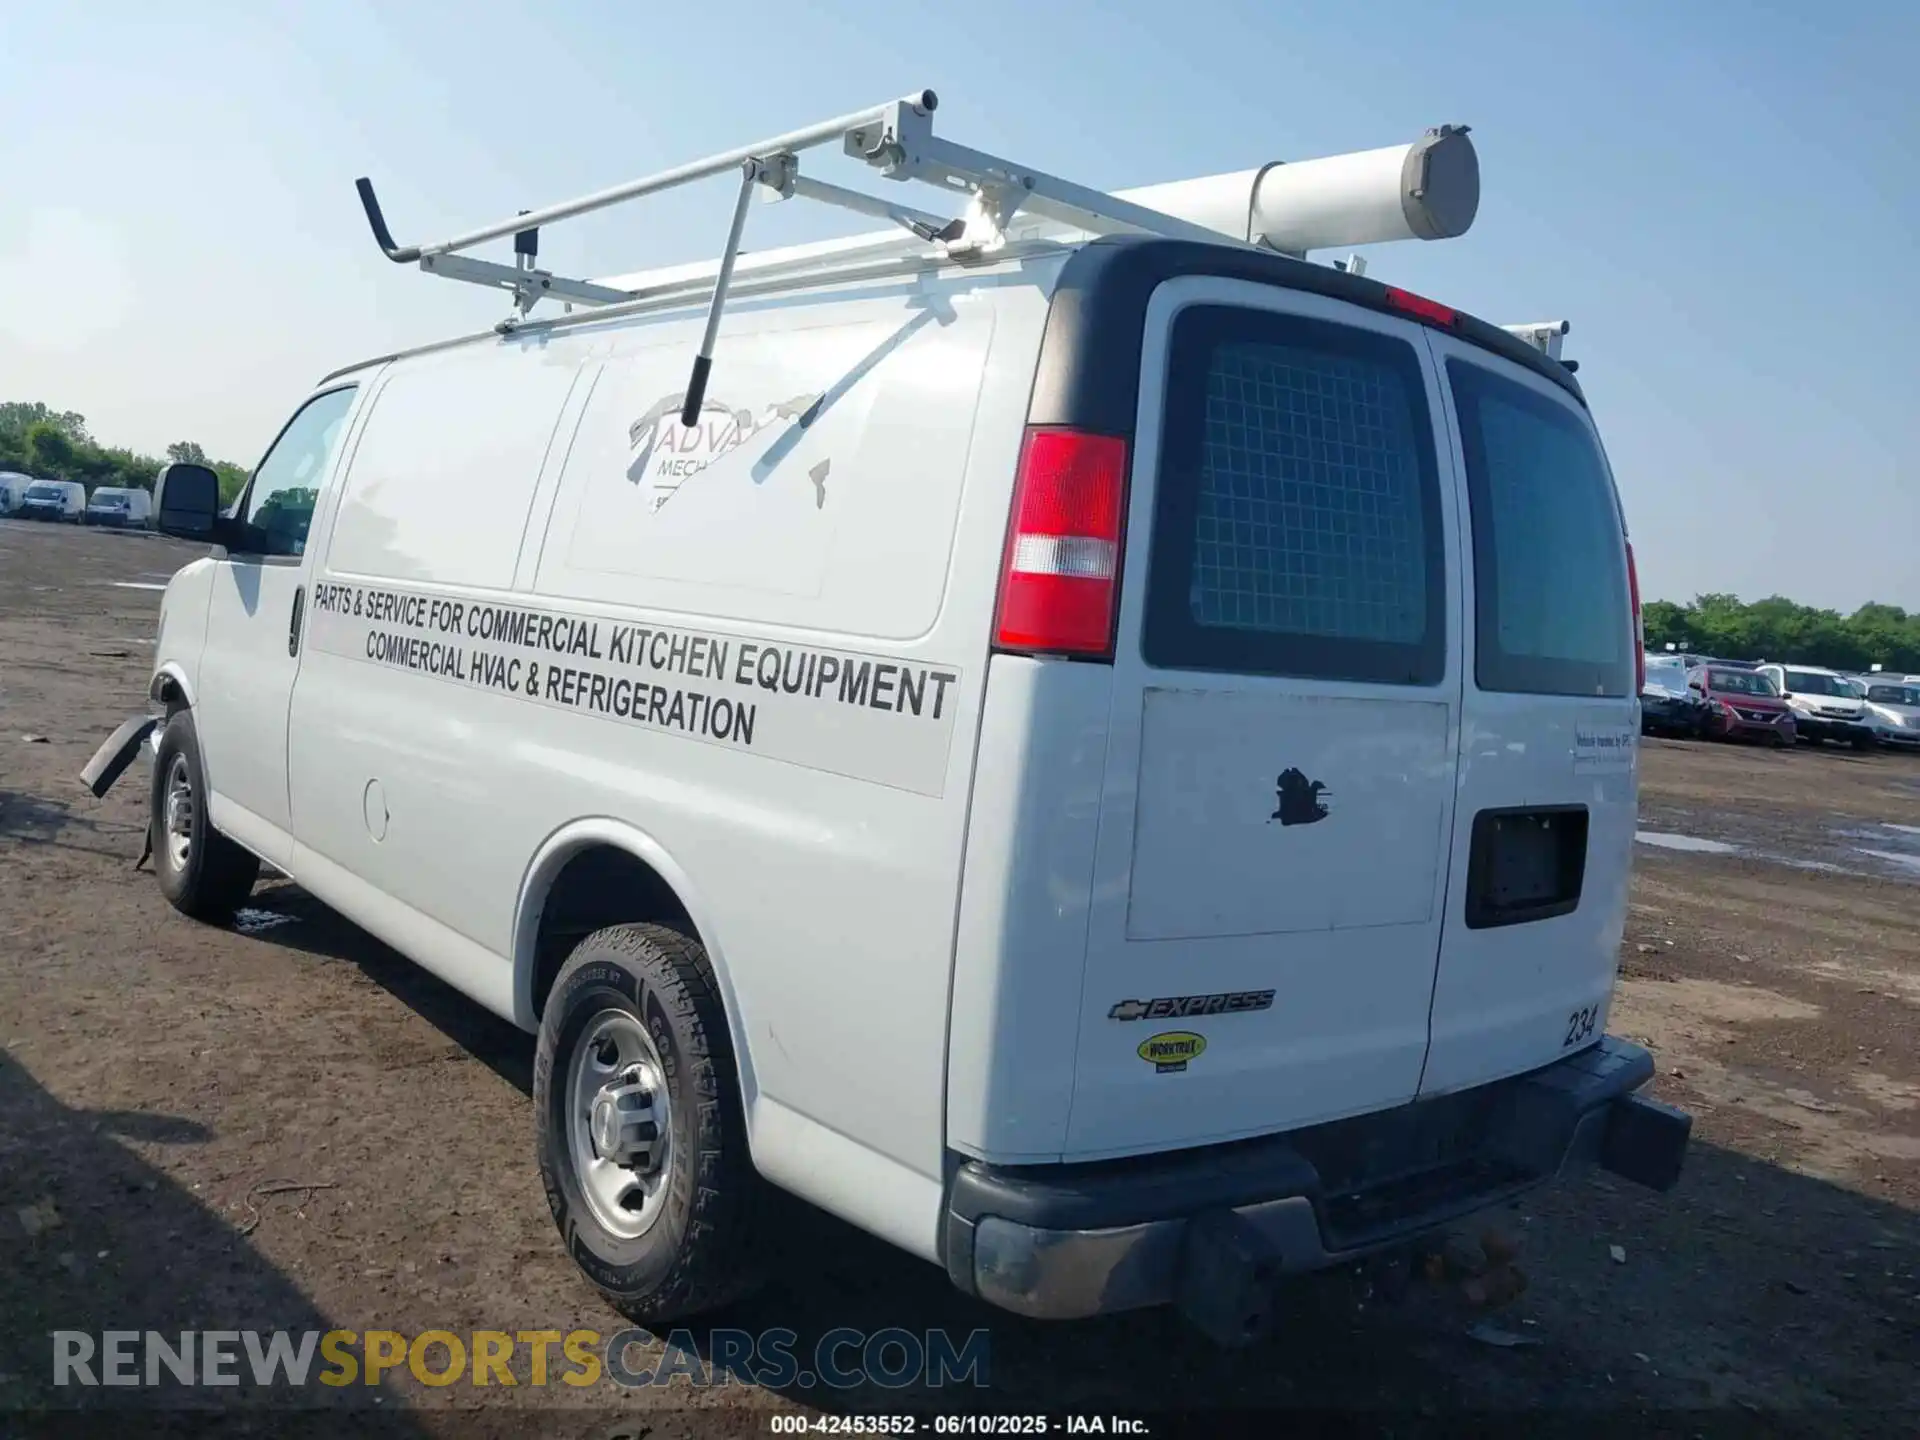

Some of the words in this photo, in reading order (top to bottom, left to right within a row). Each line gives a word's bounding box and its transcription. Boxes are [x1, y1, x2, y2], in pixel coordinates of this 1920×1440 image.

[313, 583, 352, 615] PARTS
[353, 592, 363, 616] &
[365, 591, 427, 628] SERVICE
[429, 600, 464, 634] FOR
[467, 606, 602, 659] COMMERCIAL
[608, 625, 729, 681] KITCHEN
[735, 644, 956, 720] EQUIPMENT
[366, 630, 466, 680] COMMERCIAL
[470, 651, 521, 692] HVAC
[525, 662, 540, 697] &
[545, 666, 756, 745] REFRIGERATION
[1146, 990, 1276, 1019] EXPRESS
[1564, 1003, 1599, 1047] 234
